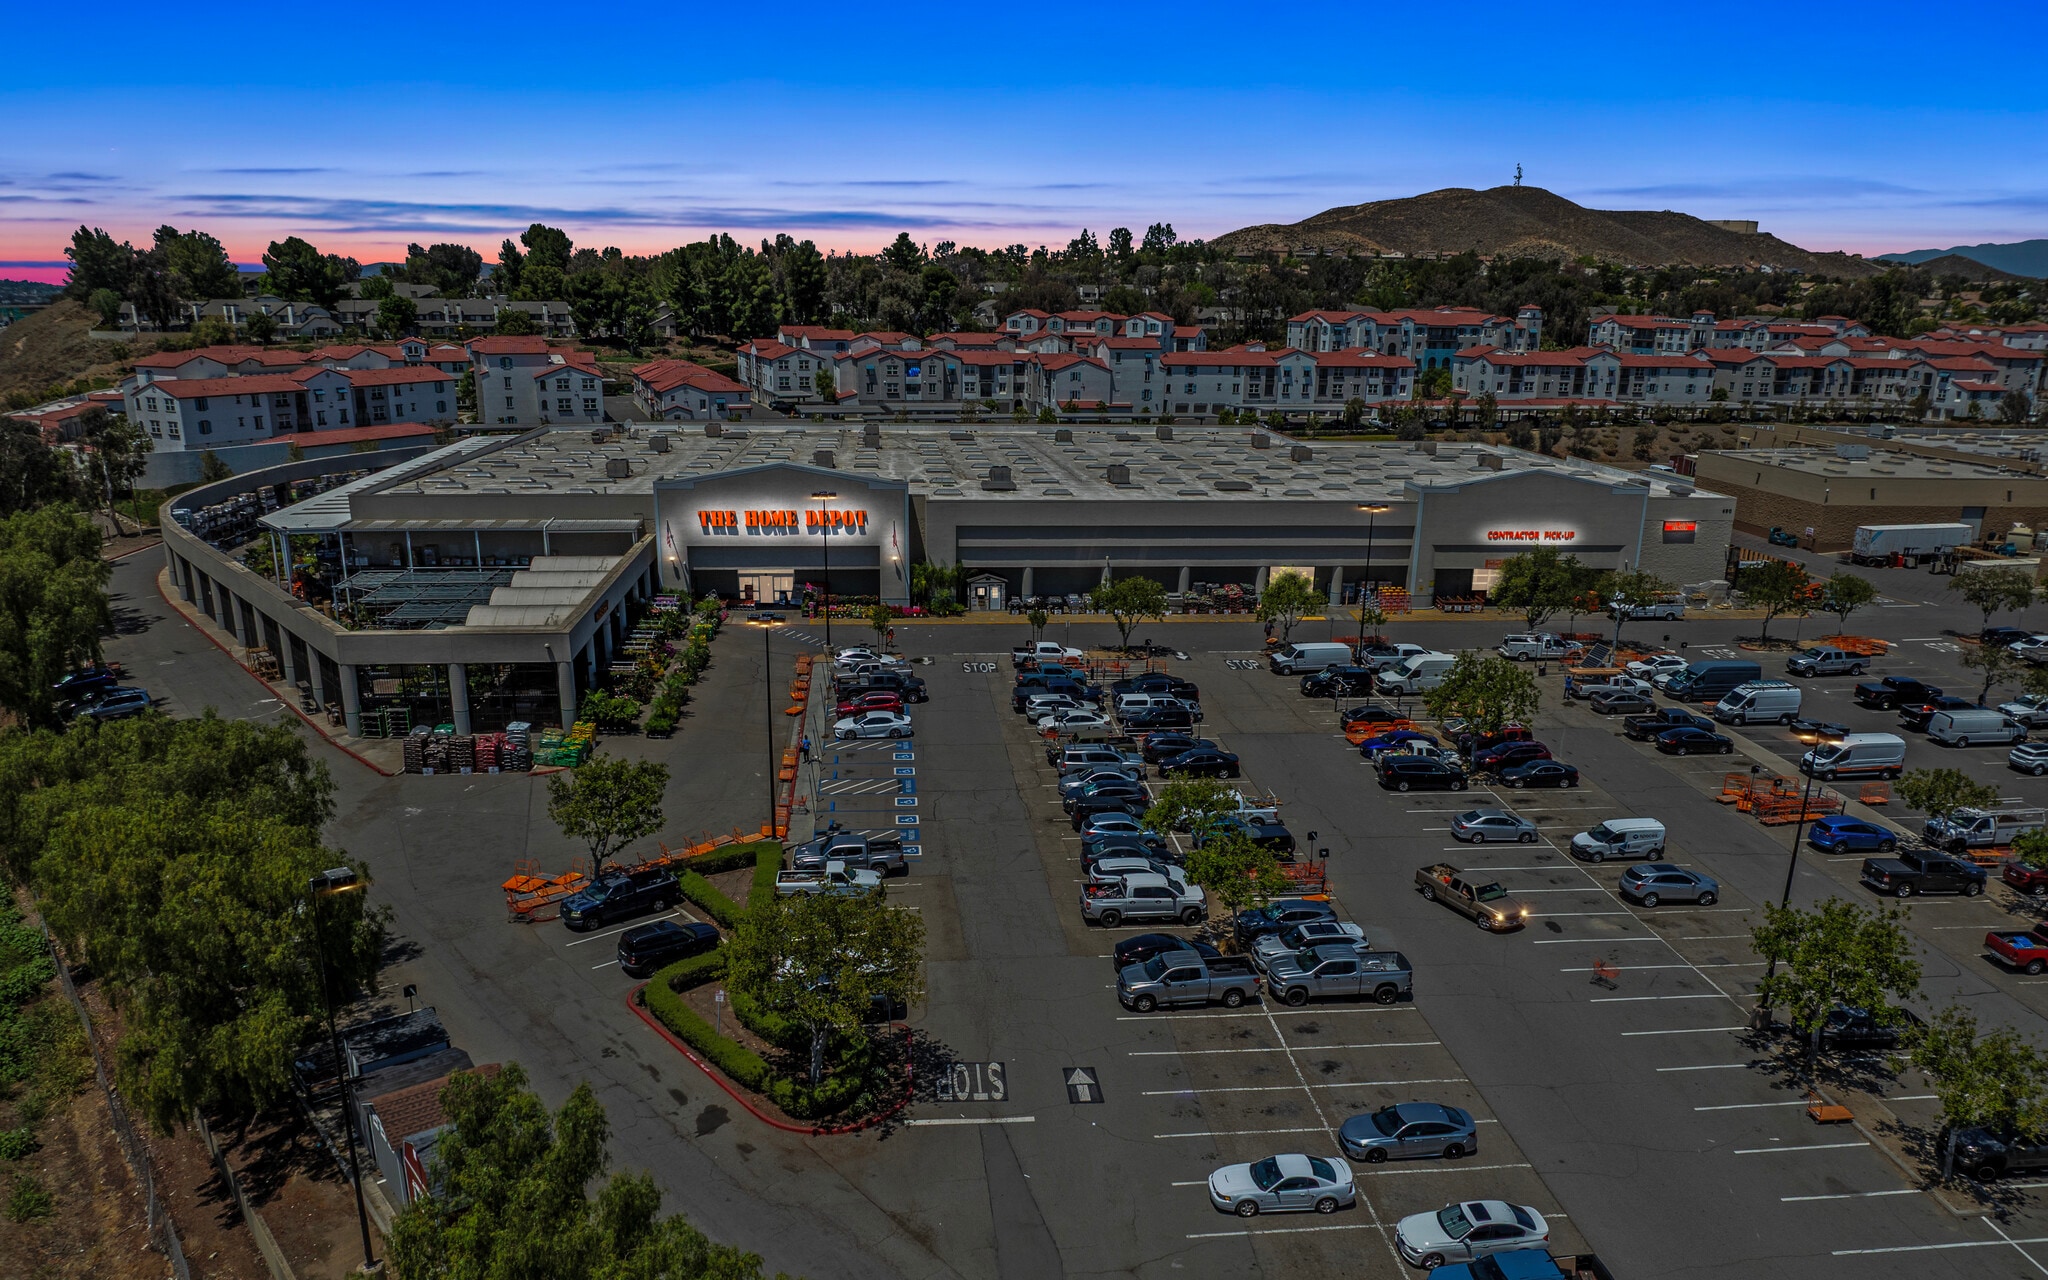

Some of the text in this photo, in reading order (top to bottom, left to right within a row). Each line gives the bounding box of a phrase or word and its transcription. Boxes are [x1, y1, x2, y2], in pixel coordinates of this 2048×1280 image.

[698, 510, 868, 527] THE HOME DEPOT
[1487, 531, 1576, 541] CONTRACTOR PICK-UP
[963, 662, 996, 673] STOP
[1225, 660, 1260, 670] STOP
[937, 1062, 1004, 1101] STOP
